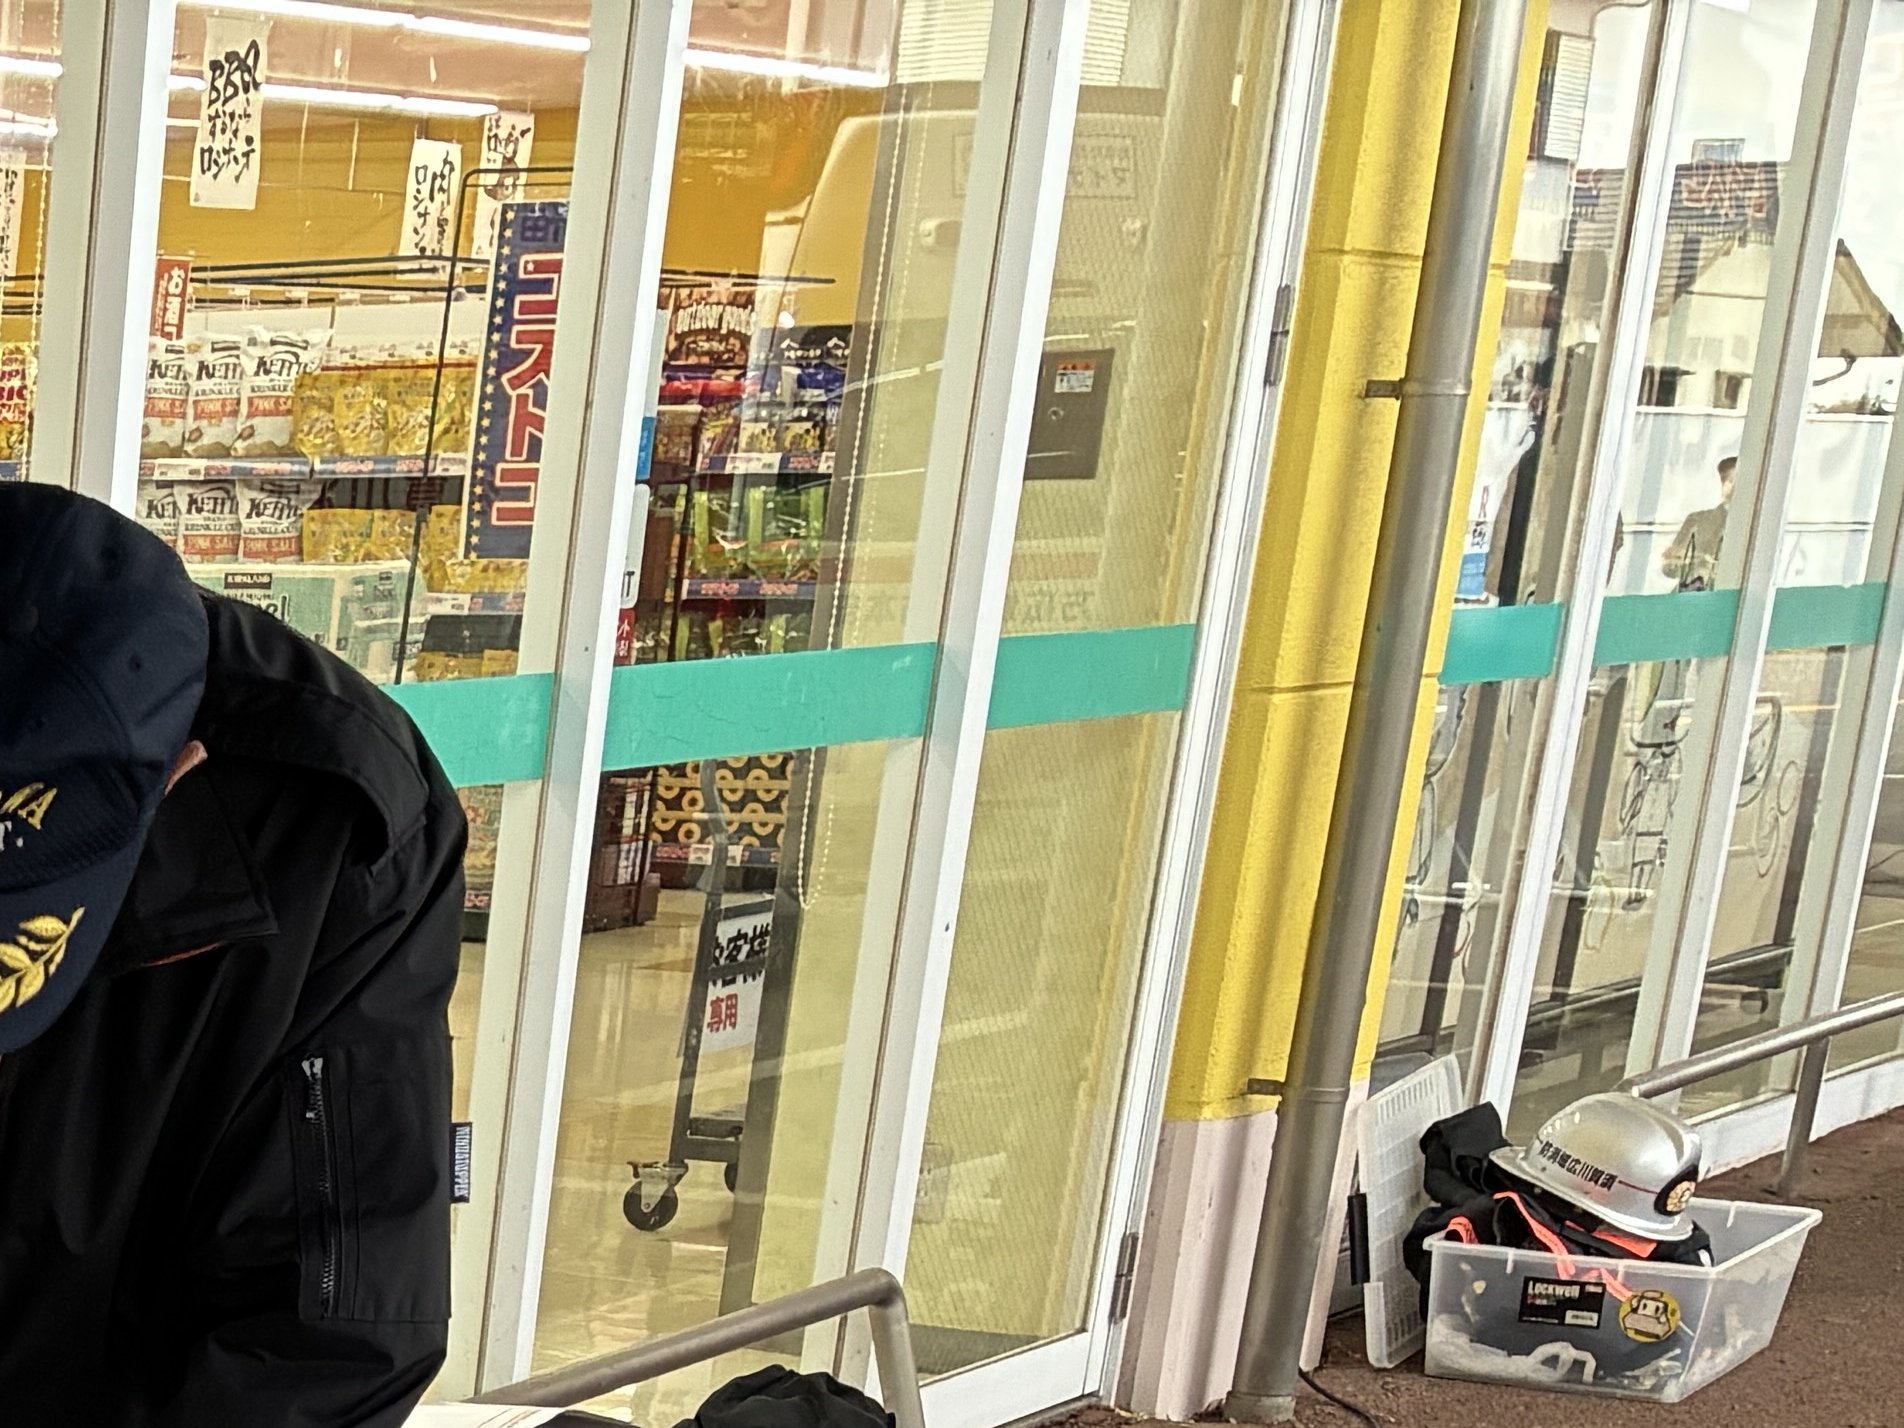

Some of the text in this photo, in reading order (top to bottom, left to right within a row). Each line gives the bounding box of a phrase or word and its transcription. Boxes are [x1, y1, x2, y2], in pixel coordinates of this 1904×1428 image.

[207, 38, 262, 110] BBQ
[412, 165, 431, 256] ロシナン
[706, 993, 739, 1033] 専用
